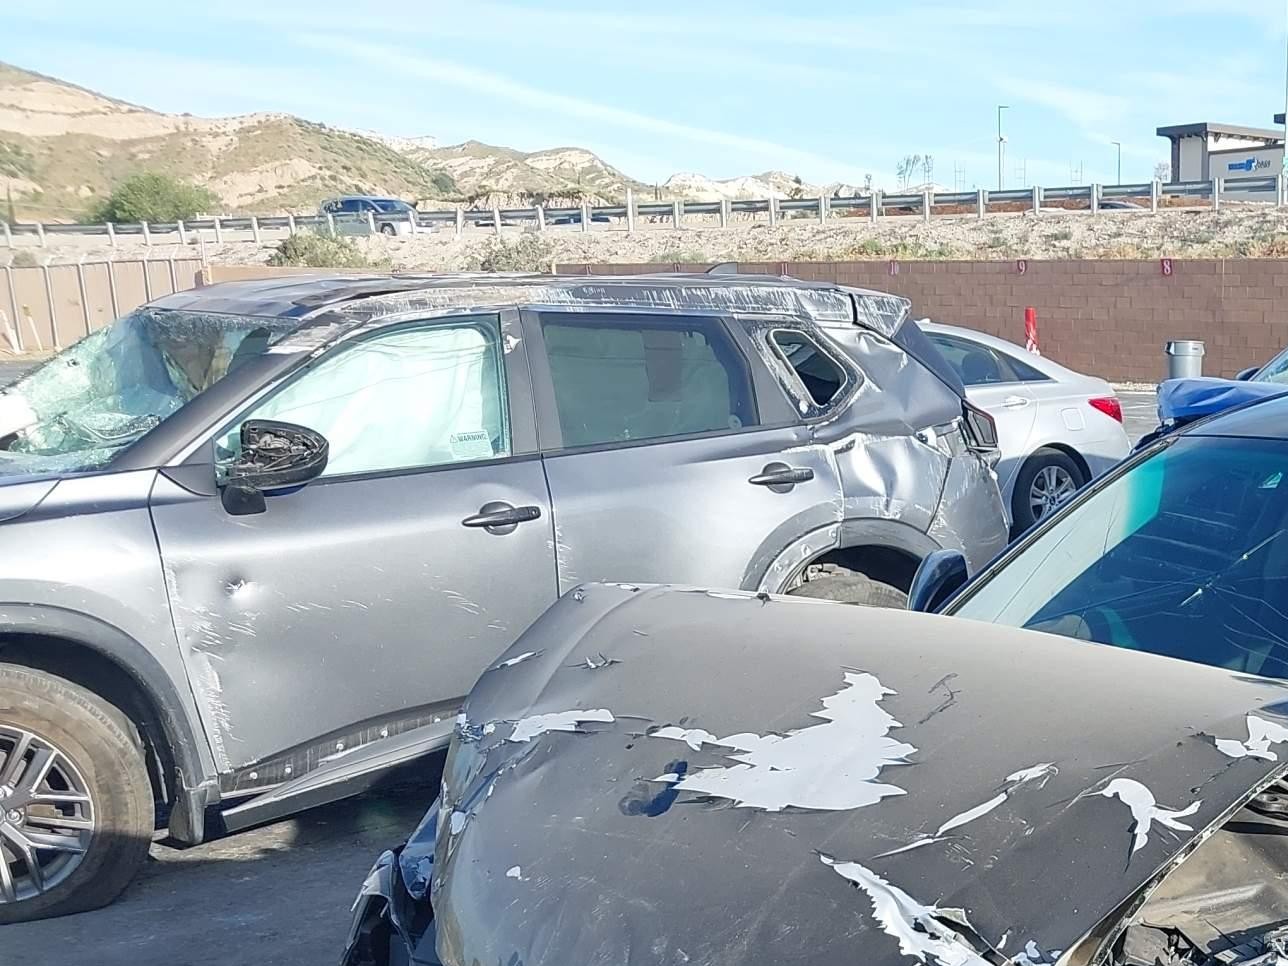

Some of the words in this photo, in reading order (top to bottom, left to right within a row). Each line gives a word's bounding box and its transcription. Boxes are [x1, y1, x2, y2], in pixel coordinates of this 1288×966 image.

[890, 261, 900, 275] 10
[1018, 260, 1026, 275] 9
[1163, 259, 1171, 275] 8
[457, 433, 489, 442] WARNING
